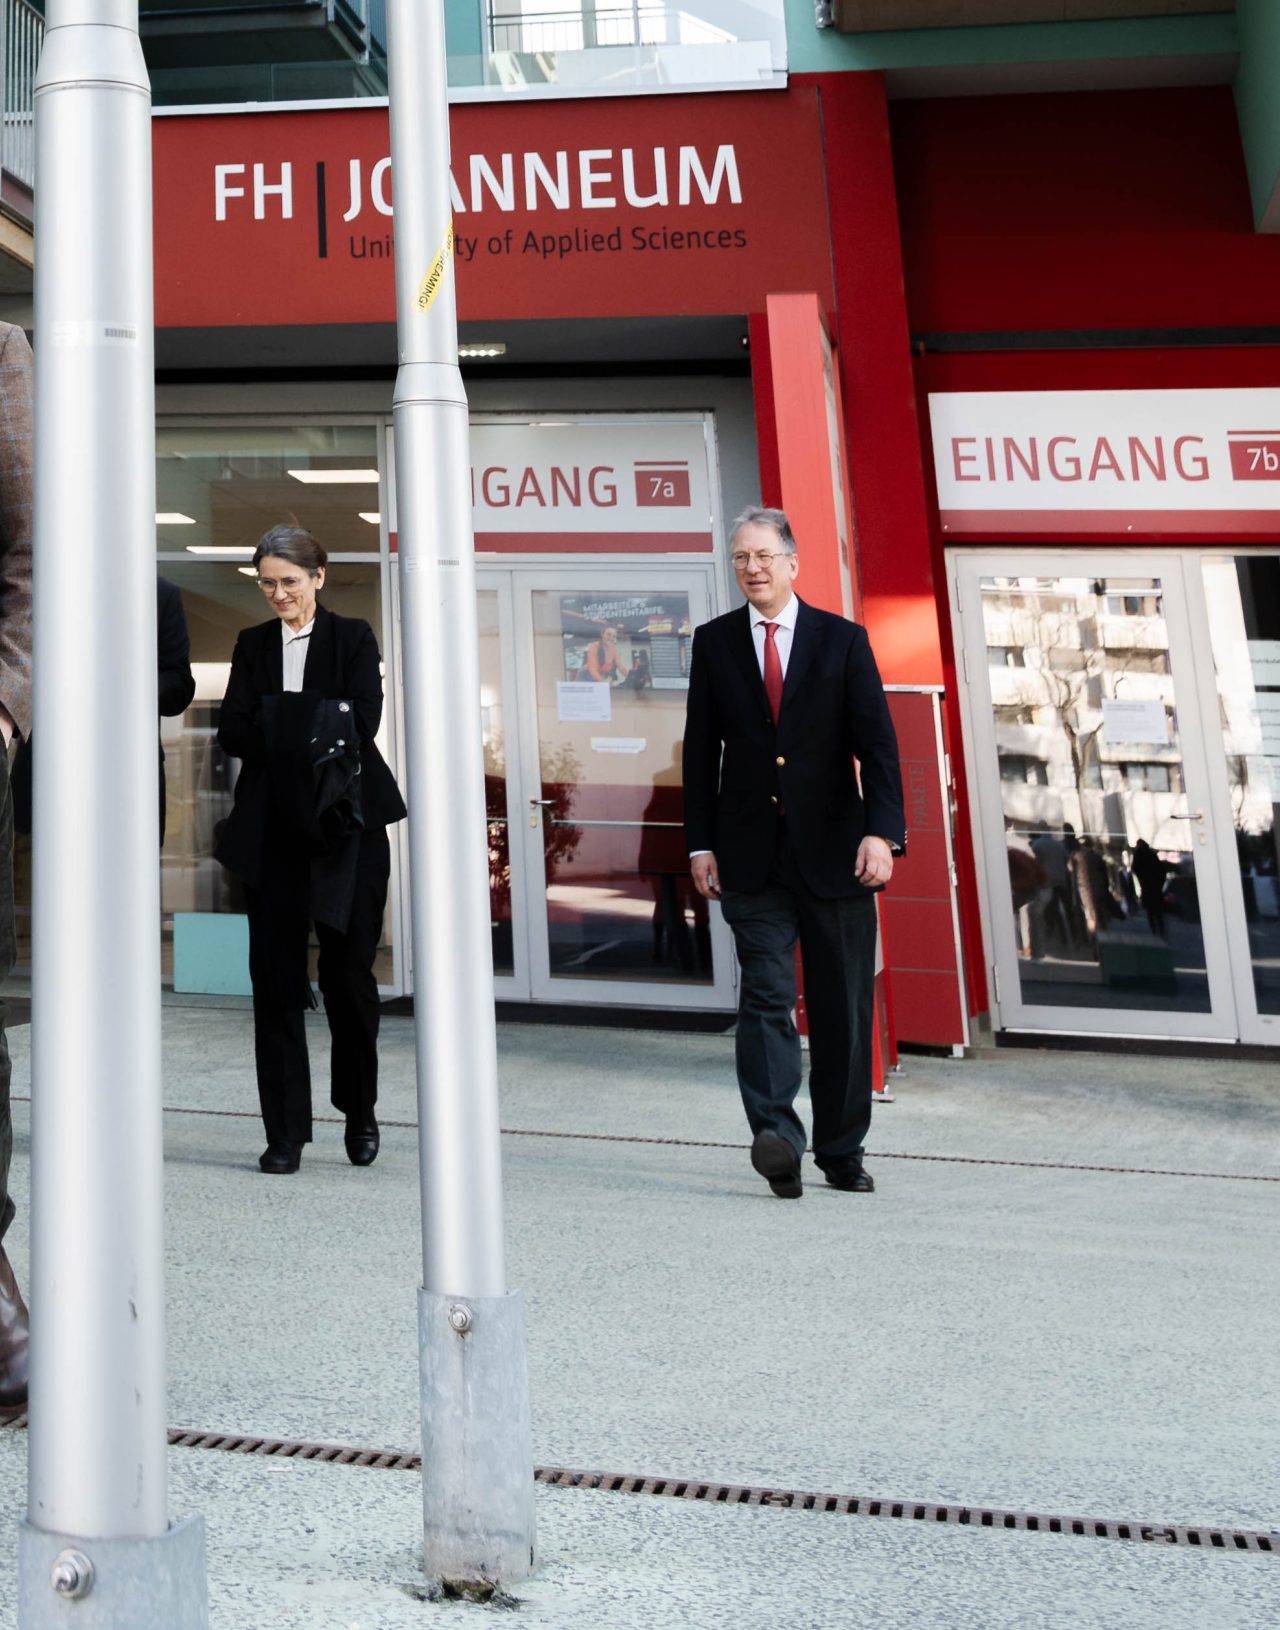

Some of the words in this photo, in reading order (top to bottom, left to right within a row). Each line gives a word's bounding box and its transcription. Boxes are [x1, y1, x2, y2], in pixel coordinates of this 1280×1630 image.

[215, 162, 293, 221] FH
[350, 235, 478, 262] Unity
[487, 229, 513, 255] of
[522, 226, 622, 259] Applied
[631, 226, 748, 250] Sciences
[951, 436, 1210, 482] EINGANG
[1247, 446, 1279, 472] 7b
[471, 466, 618, 508] GANG
[649, 477, 675, 498] 7a
